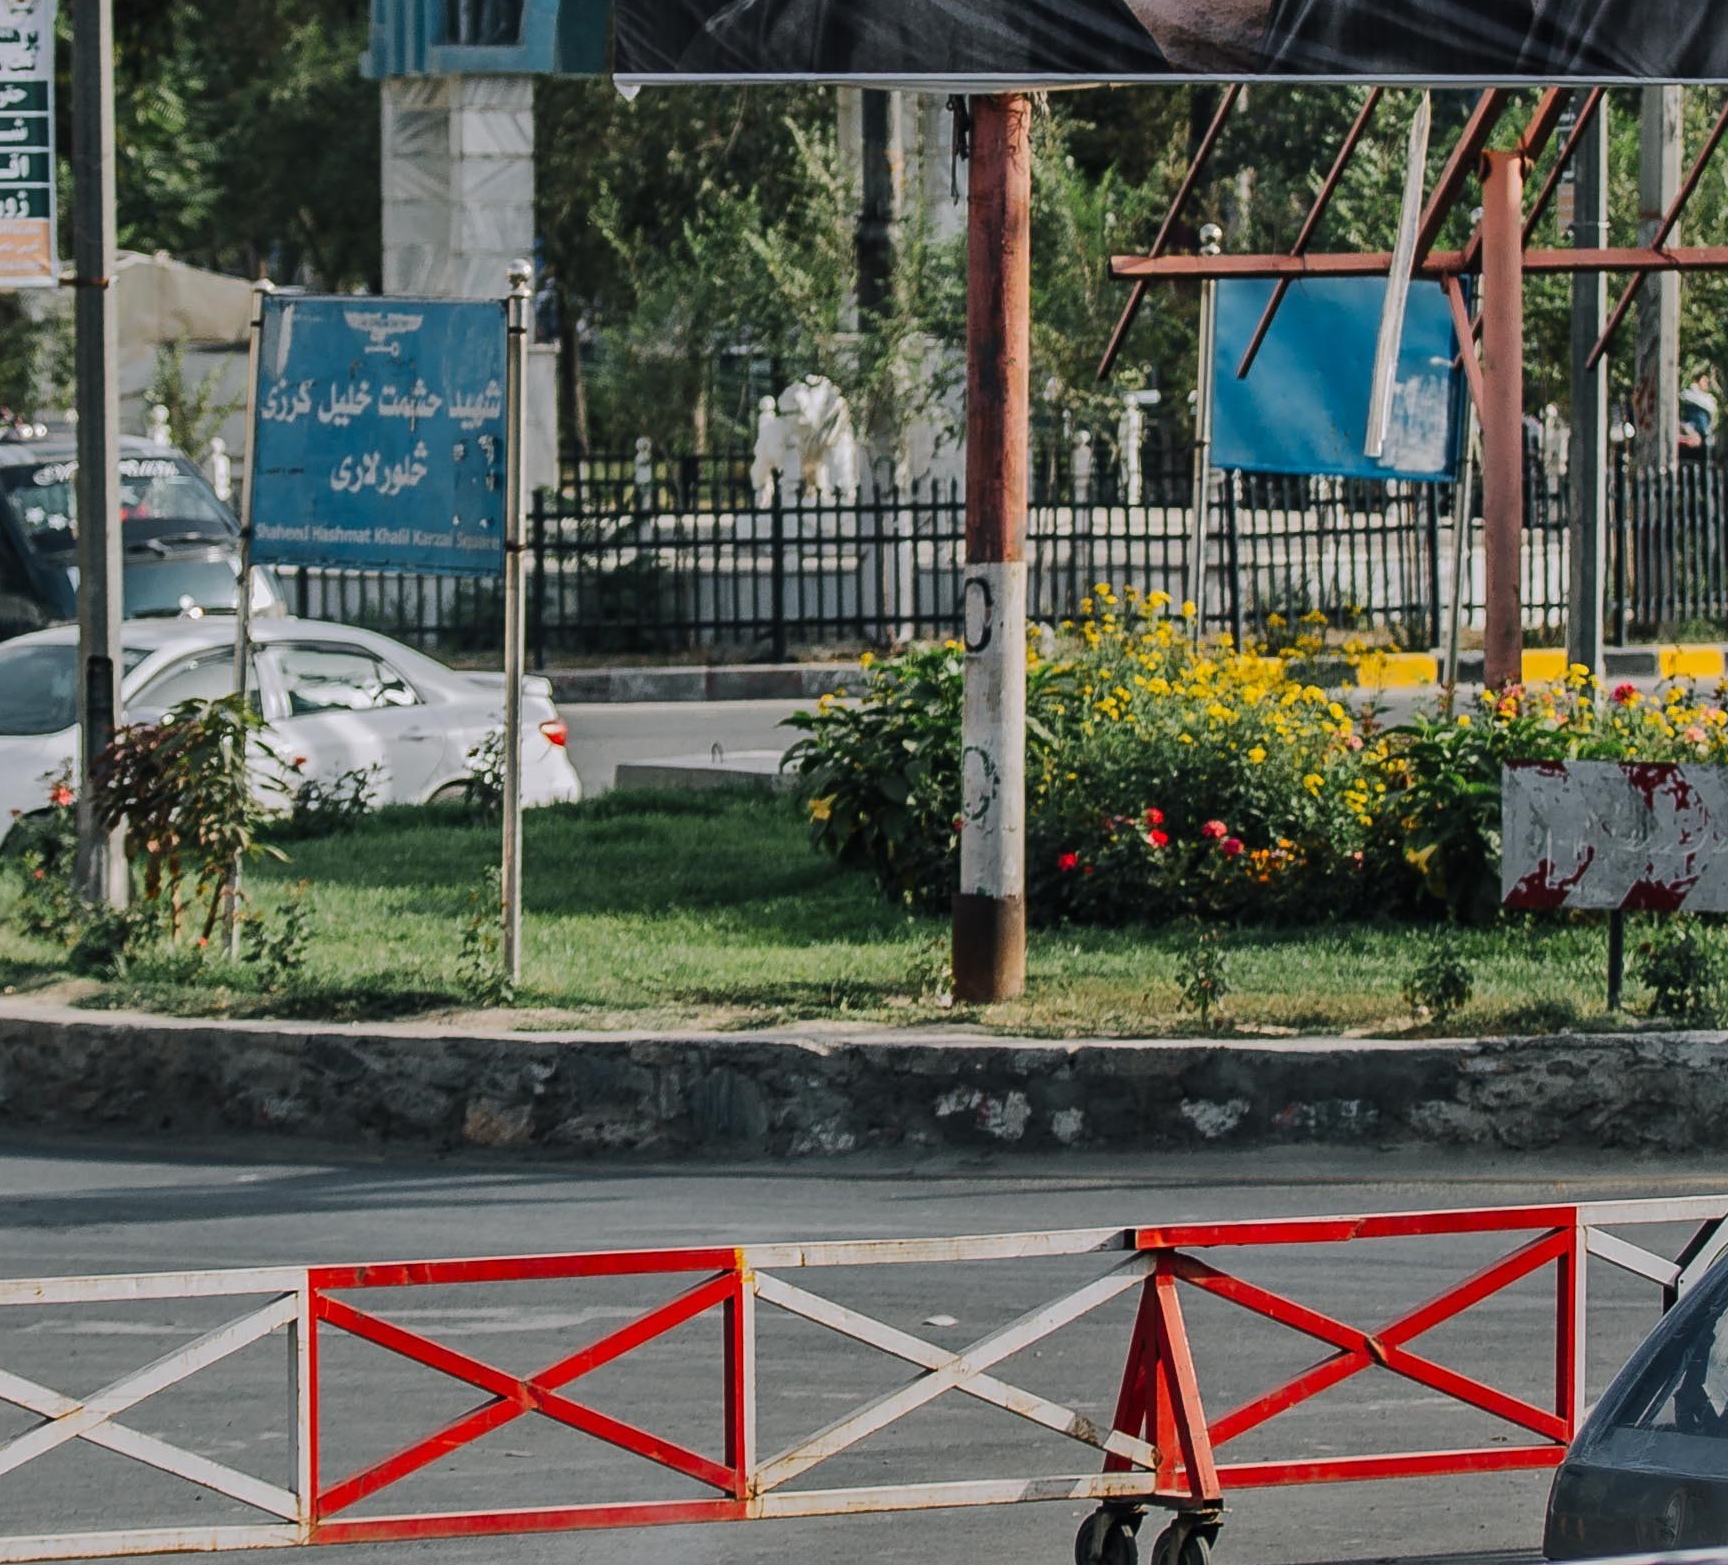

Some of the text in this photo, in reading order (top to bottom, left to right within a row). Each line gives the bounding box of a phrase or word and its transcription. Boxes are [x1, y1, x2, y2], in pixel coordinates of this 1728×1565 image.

[317, 380, 372, 425] خلیل
[378, 378, 442, 420] حشمت
[448, 380, 502, 431] شهید
[254, 522, 308, 540] Shaheed
[313, 524, 371, 543] Hashmat
[374, 526, 410, 545] Khalil
[412, 529, 453, 547] Karzai
